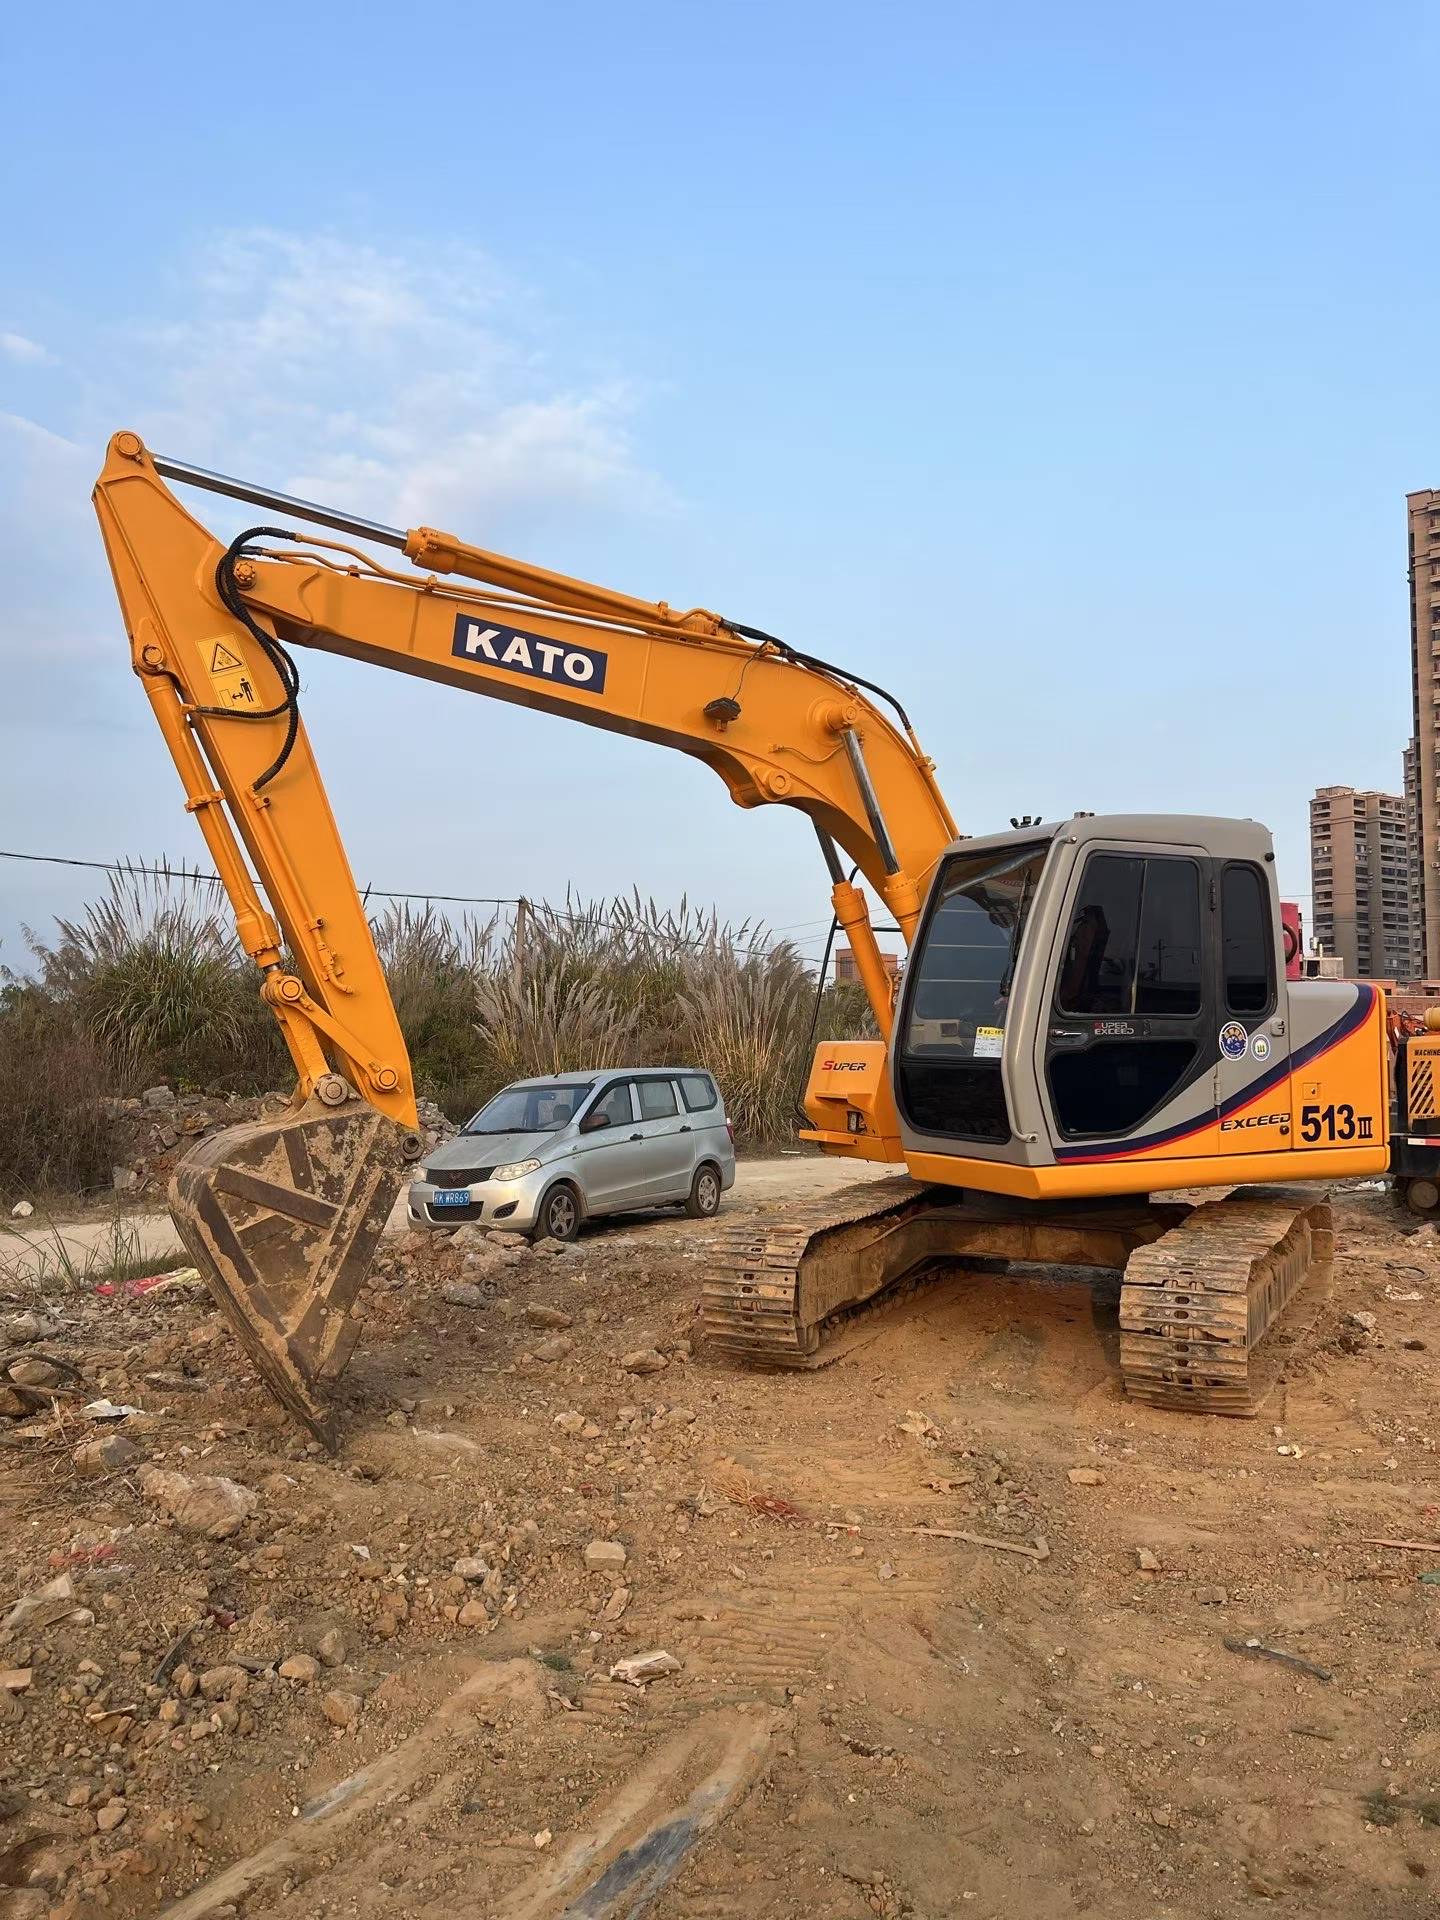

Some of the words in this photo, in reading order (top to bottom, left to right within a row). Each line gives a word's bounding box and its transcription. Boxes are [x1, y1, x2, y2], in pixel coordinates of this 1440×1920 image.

[466, 624, 594, 682] KATO
[822, 1061, 866, 1071] SUPER
[1221, 1113, 1290, 1131] EXCEED
